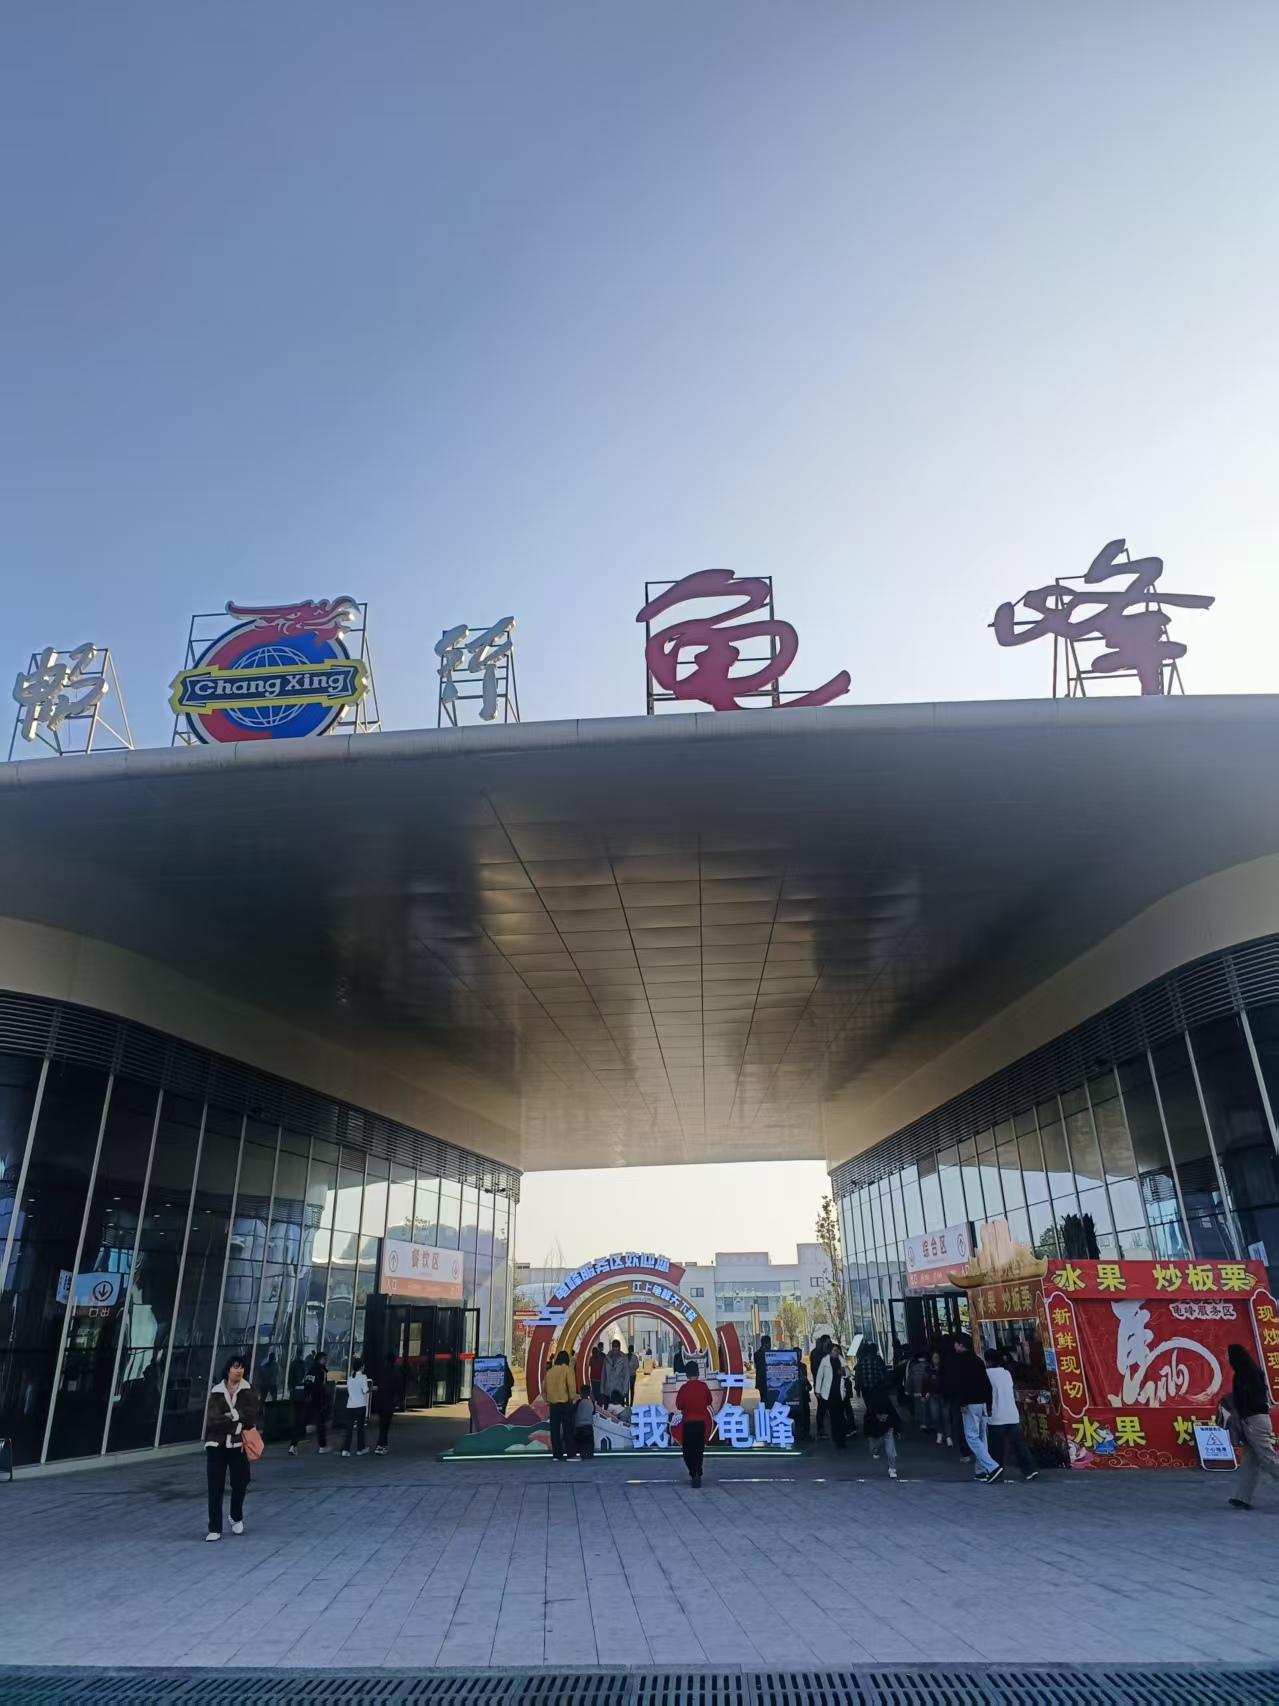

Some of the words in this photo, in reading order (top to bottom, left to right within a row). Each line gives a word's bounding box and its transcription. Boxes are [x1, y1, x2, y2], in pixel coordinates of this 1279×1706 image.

[194, 678, 281, 698] Chang
[285, 673, 346, 691] Xing
[411, 1248, 439, 1270] 餐饮区
[922, 1235, 947, 1257] 综合区
[1054, 1264, 1127, 1292] 水果
[1152, 1264, 1250, 1291] 炒板栗
[1172, 1304, 1234, 1318] 龟峰服务区
[1052, 1308, 1082, 1398] 新鲜现切
[630, 1404, 669, 1448] 我
[714, 1402, 795, 1448] 龟峰
[1072, 1416, 1146, 1446] 水果
